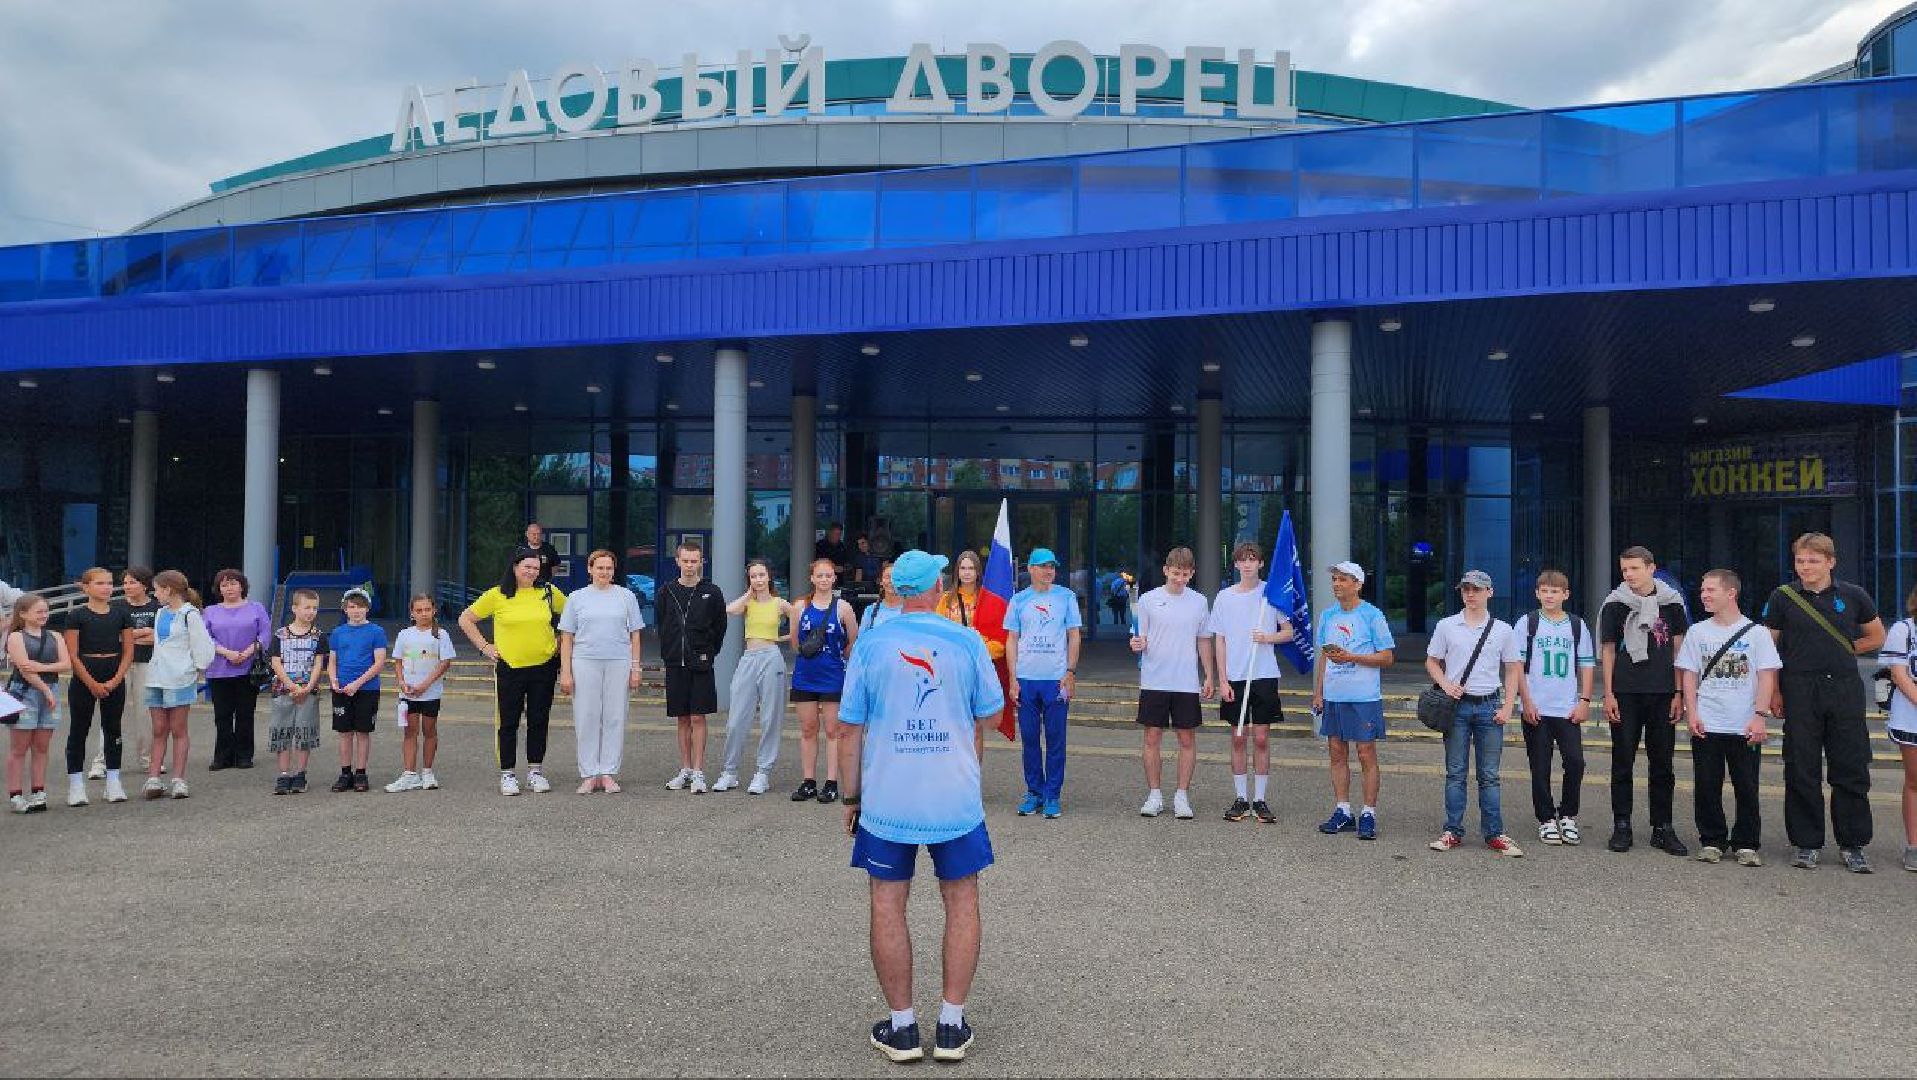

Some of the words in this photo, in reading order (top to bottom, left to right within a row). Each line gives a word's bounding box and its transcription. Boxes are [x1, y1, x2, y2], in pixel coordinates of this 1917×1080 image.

[391, 34, 824, 152] ЛЕДОВЫЙ
[886, 40, 1298, 119] ДВОРЕЦ
[1690, 453, 1825, 498] ХОККЕЙ
[1543, 650, 1568, 678] 10
[893, 732, 950, 742] ГАРМОНИИ
[906, 719, 936, 730] БЕГ
